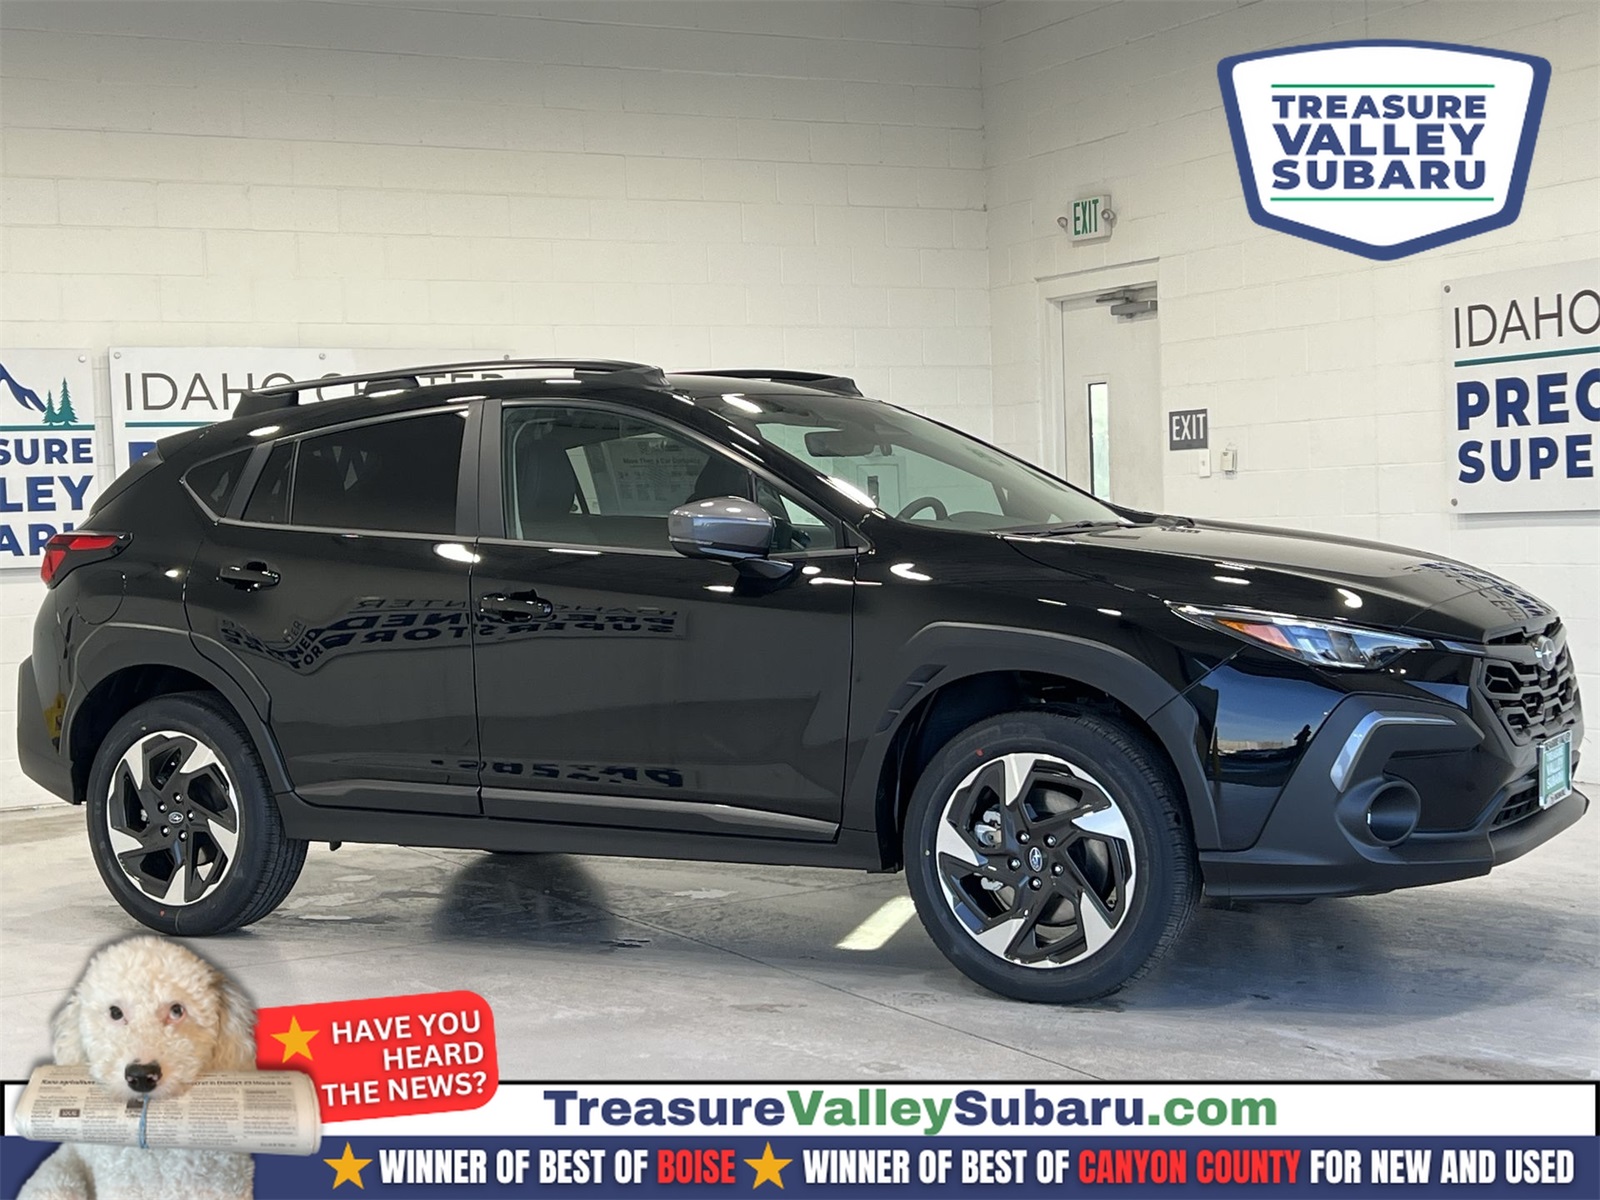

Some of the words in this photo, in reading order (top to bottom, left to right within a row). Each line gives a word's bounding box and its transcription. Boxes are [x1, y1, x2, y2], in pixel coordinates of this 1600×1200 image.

[1073, 198, 1099, 236] EXIT
[1454, 289, 1600, 349] IDAHO
[1172, 413, 1206, 441] EXIT
[1458, 434, 1594, 484] SUPE
